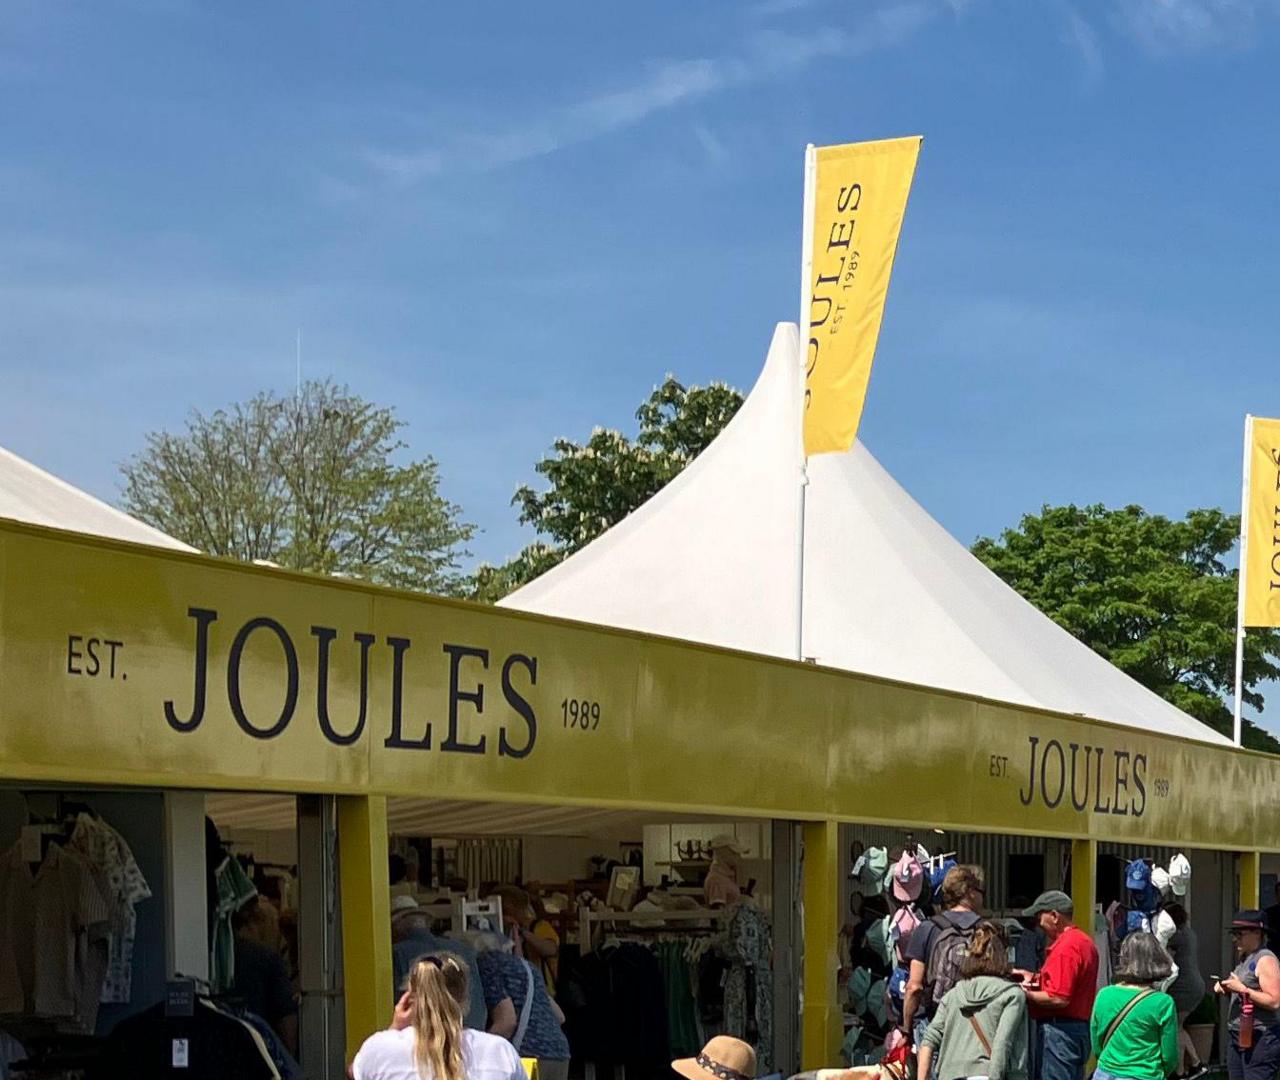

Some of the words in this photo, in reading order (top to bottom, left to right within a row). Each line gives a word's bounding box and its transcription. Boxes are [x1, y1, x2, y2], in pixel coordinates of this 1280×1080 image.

[842, 250, 861, 291] 1989
[67, 634, 128, 683] EST.
[163, 606, 539, 759] JOULES
[560, 698, 601, 731] 1989
[1020, 736, 1149, 818] JOULES
